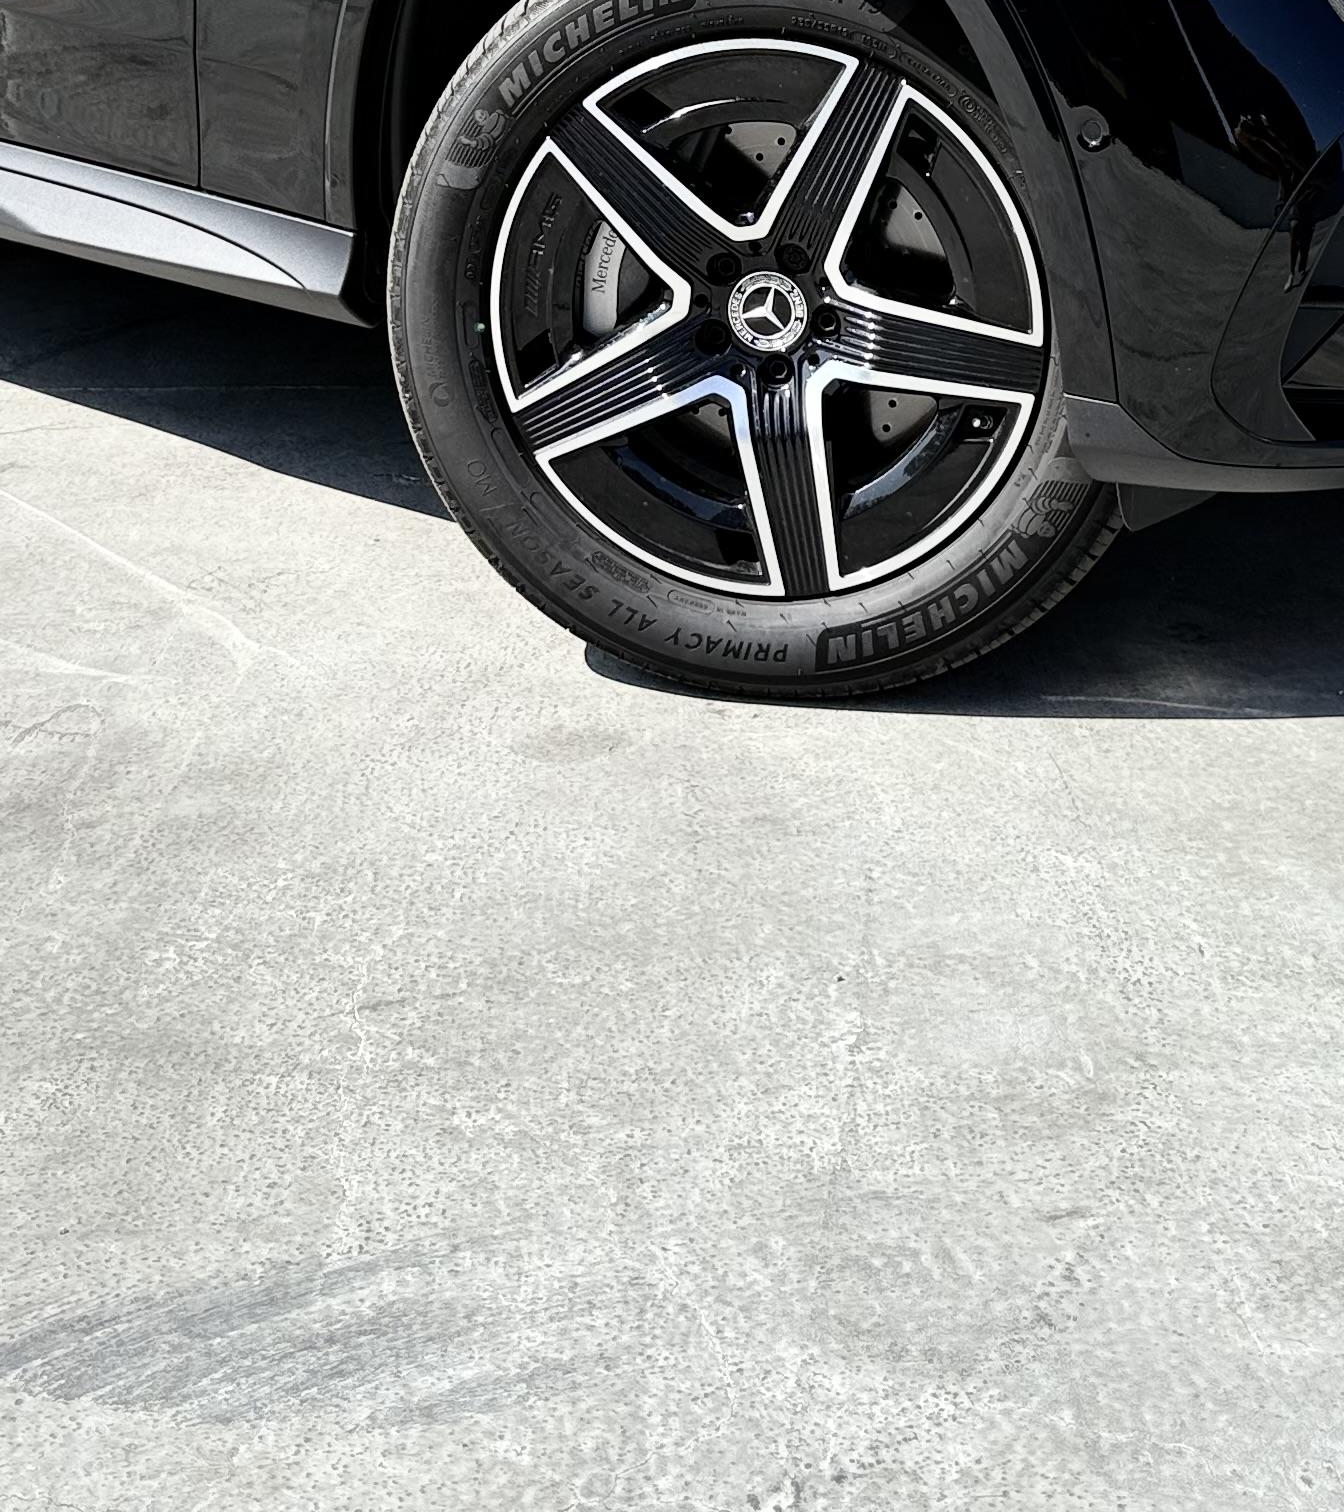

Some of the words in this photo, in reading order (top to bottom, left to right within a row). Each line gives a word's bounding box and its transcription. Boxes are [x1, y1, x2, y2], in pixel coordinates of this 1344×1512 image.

[731, 291, 754, 343] MERCEDES
[789, 288, 804, 319] BENZ
[506, 521, 601, 600] SEASON
[607, 597, 657, 632] ALL
[826, 538, 1030, 665] MICHELIN
[664, 626, 789, 663] PRIMACY
